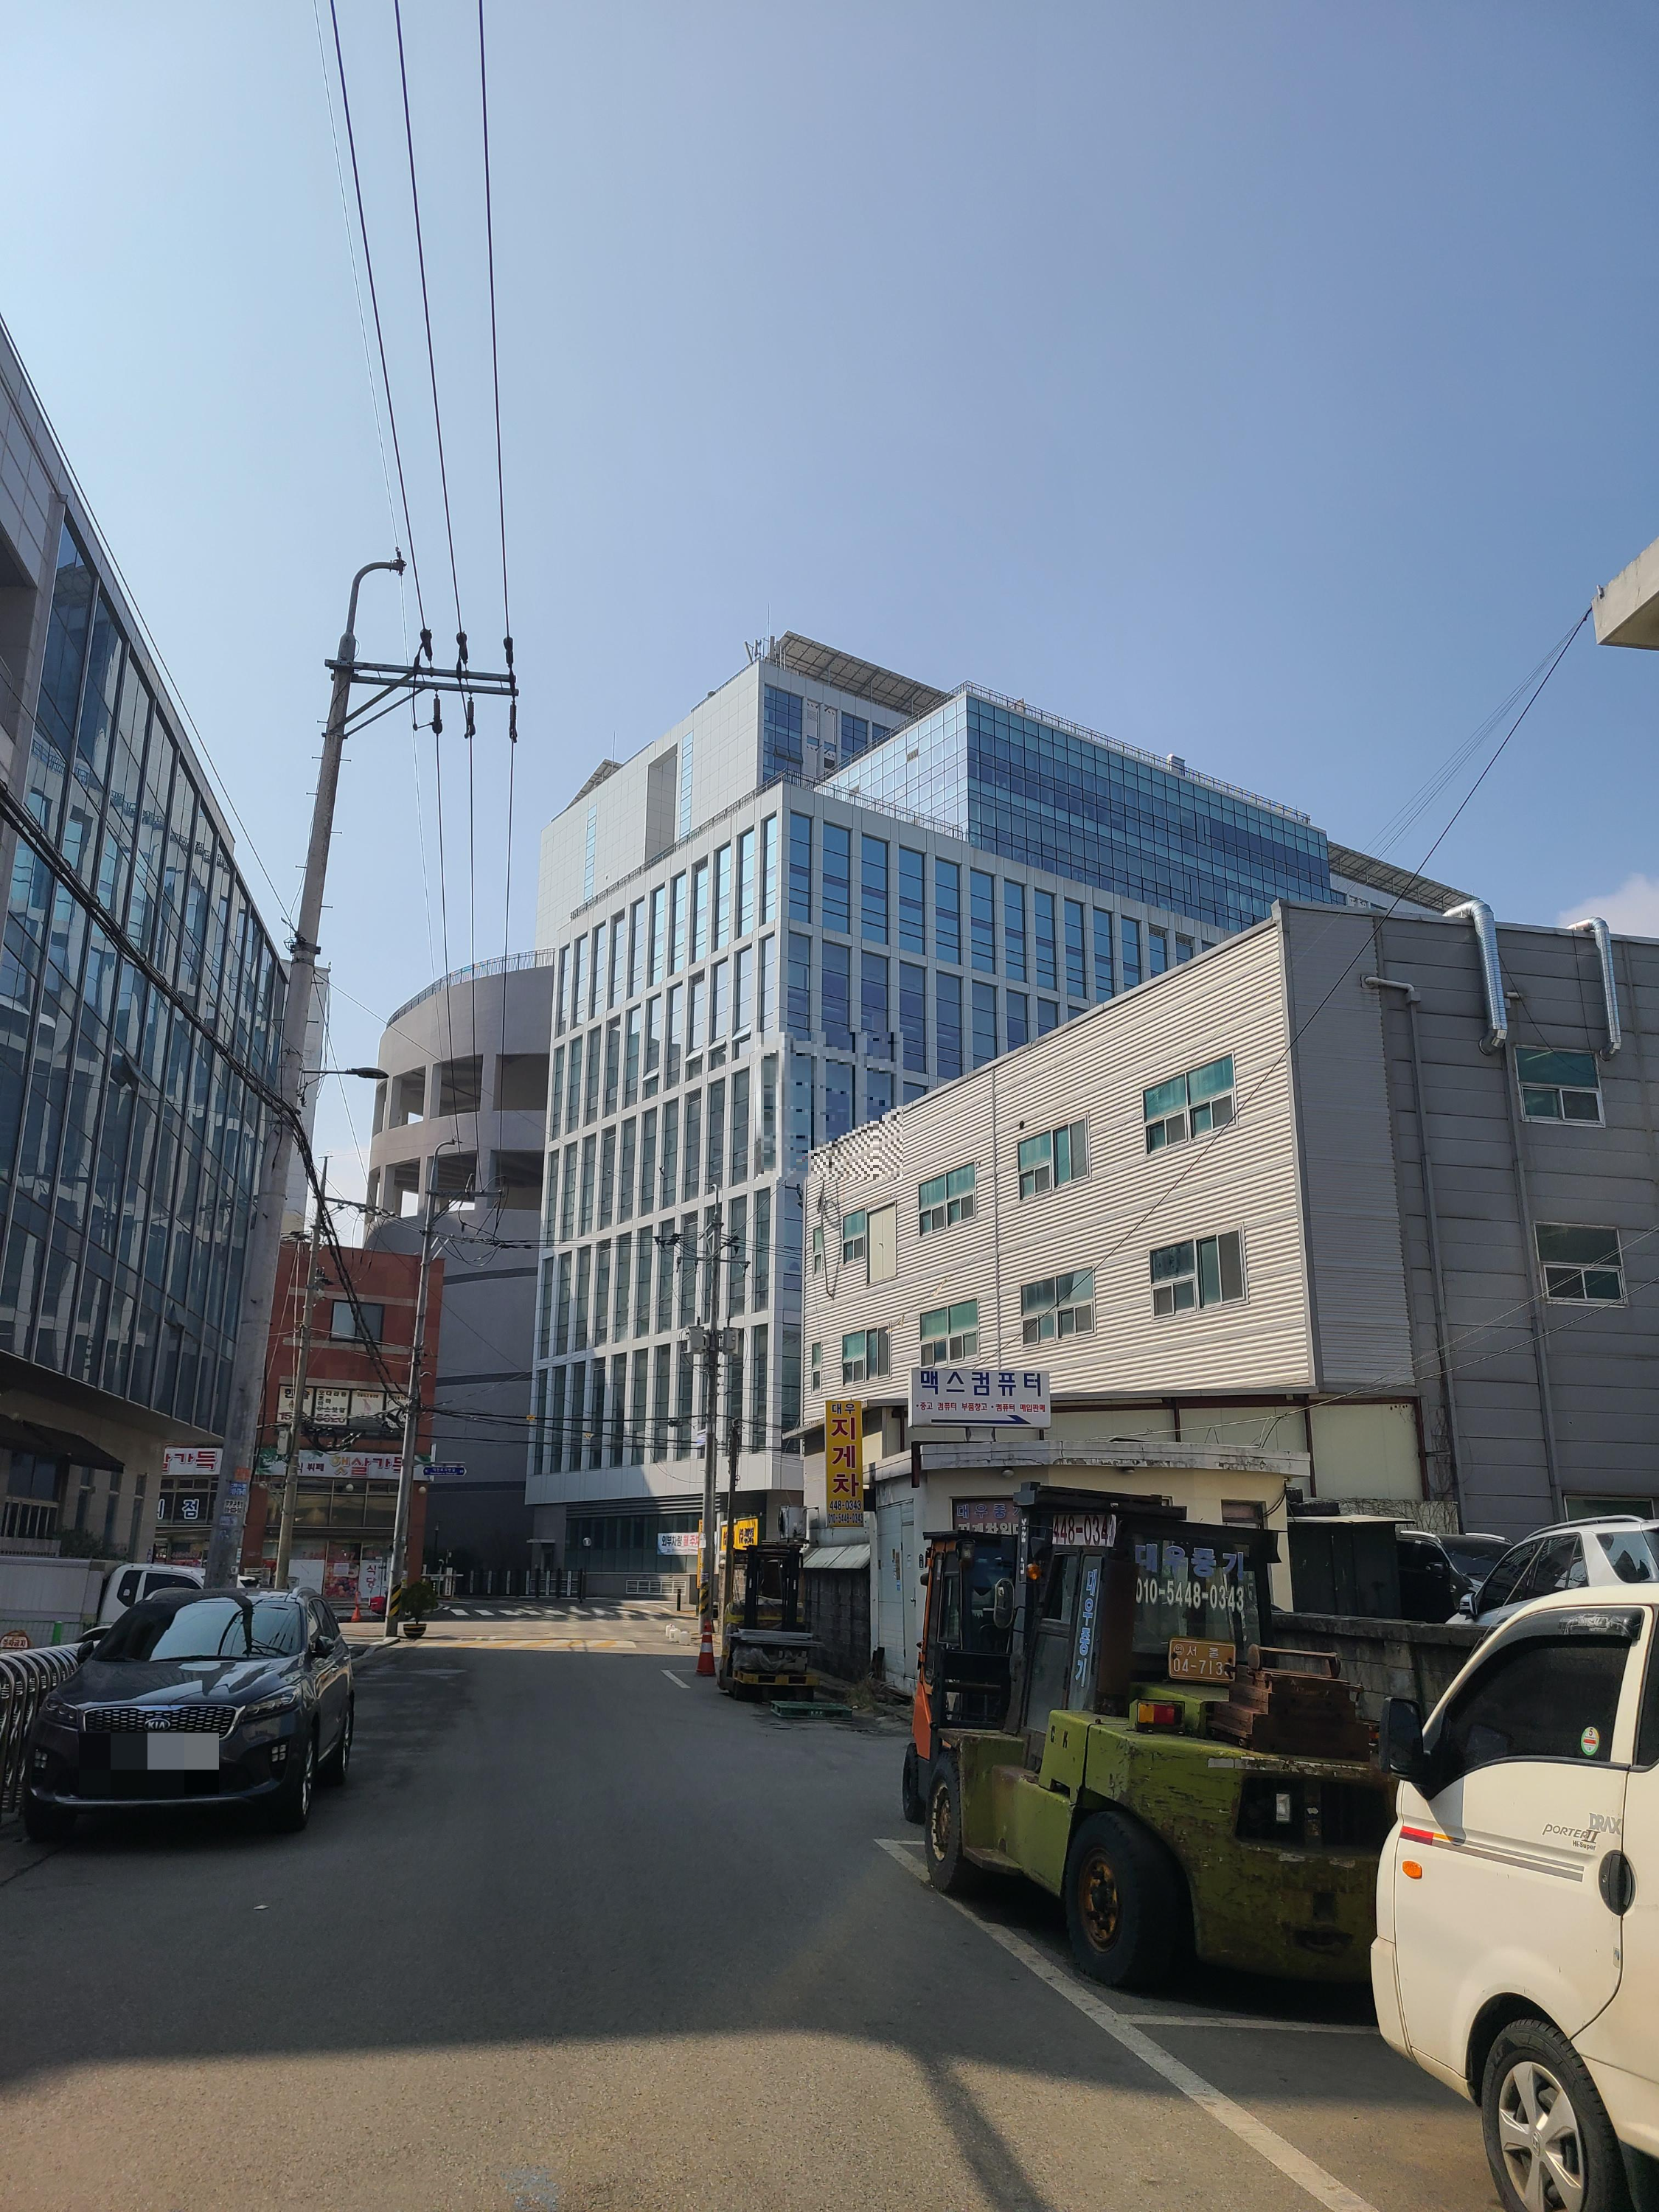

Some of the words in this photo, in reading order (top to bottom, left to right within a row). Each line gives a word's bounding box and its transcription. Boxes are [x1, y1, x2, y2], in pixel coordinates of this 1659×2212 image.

[920, 1370, 1042, 1397] 맥스컴퓨터
[832, 1403, 856, 1415] 대우
[919, 1402, 933, 1411] 중고
[937, 1402, 957, 1411] 컴퓨터
[961, 1402, 988, 1412] 부품창고
[995, 1403, 1015, 1412] 컴퓨터
[1019, 1404, 1046, 1413] 매입판매
[831, 1417, 860, 1498] 지게차
[830, 1500, 861, 1511] 448-0343
[828, 1513, 863, 1524] 010-5448-0343
[1135, 1543, 1245, 1582] 대우중기
[1135, 1576, 1245, 1613] 010-5448-0343
[1074, 1568, 1098, 1687] 대우중기
[148, 1720, 167, 1730] KIA
[1588, 1728, 1593, 1736] 5
[1589, 1812, 1622, 1835] DRAX
[1572, 1840, 1596, 1851] Hi-Super
